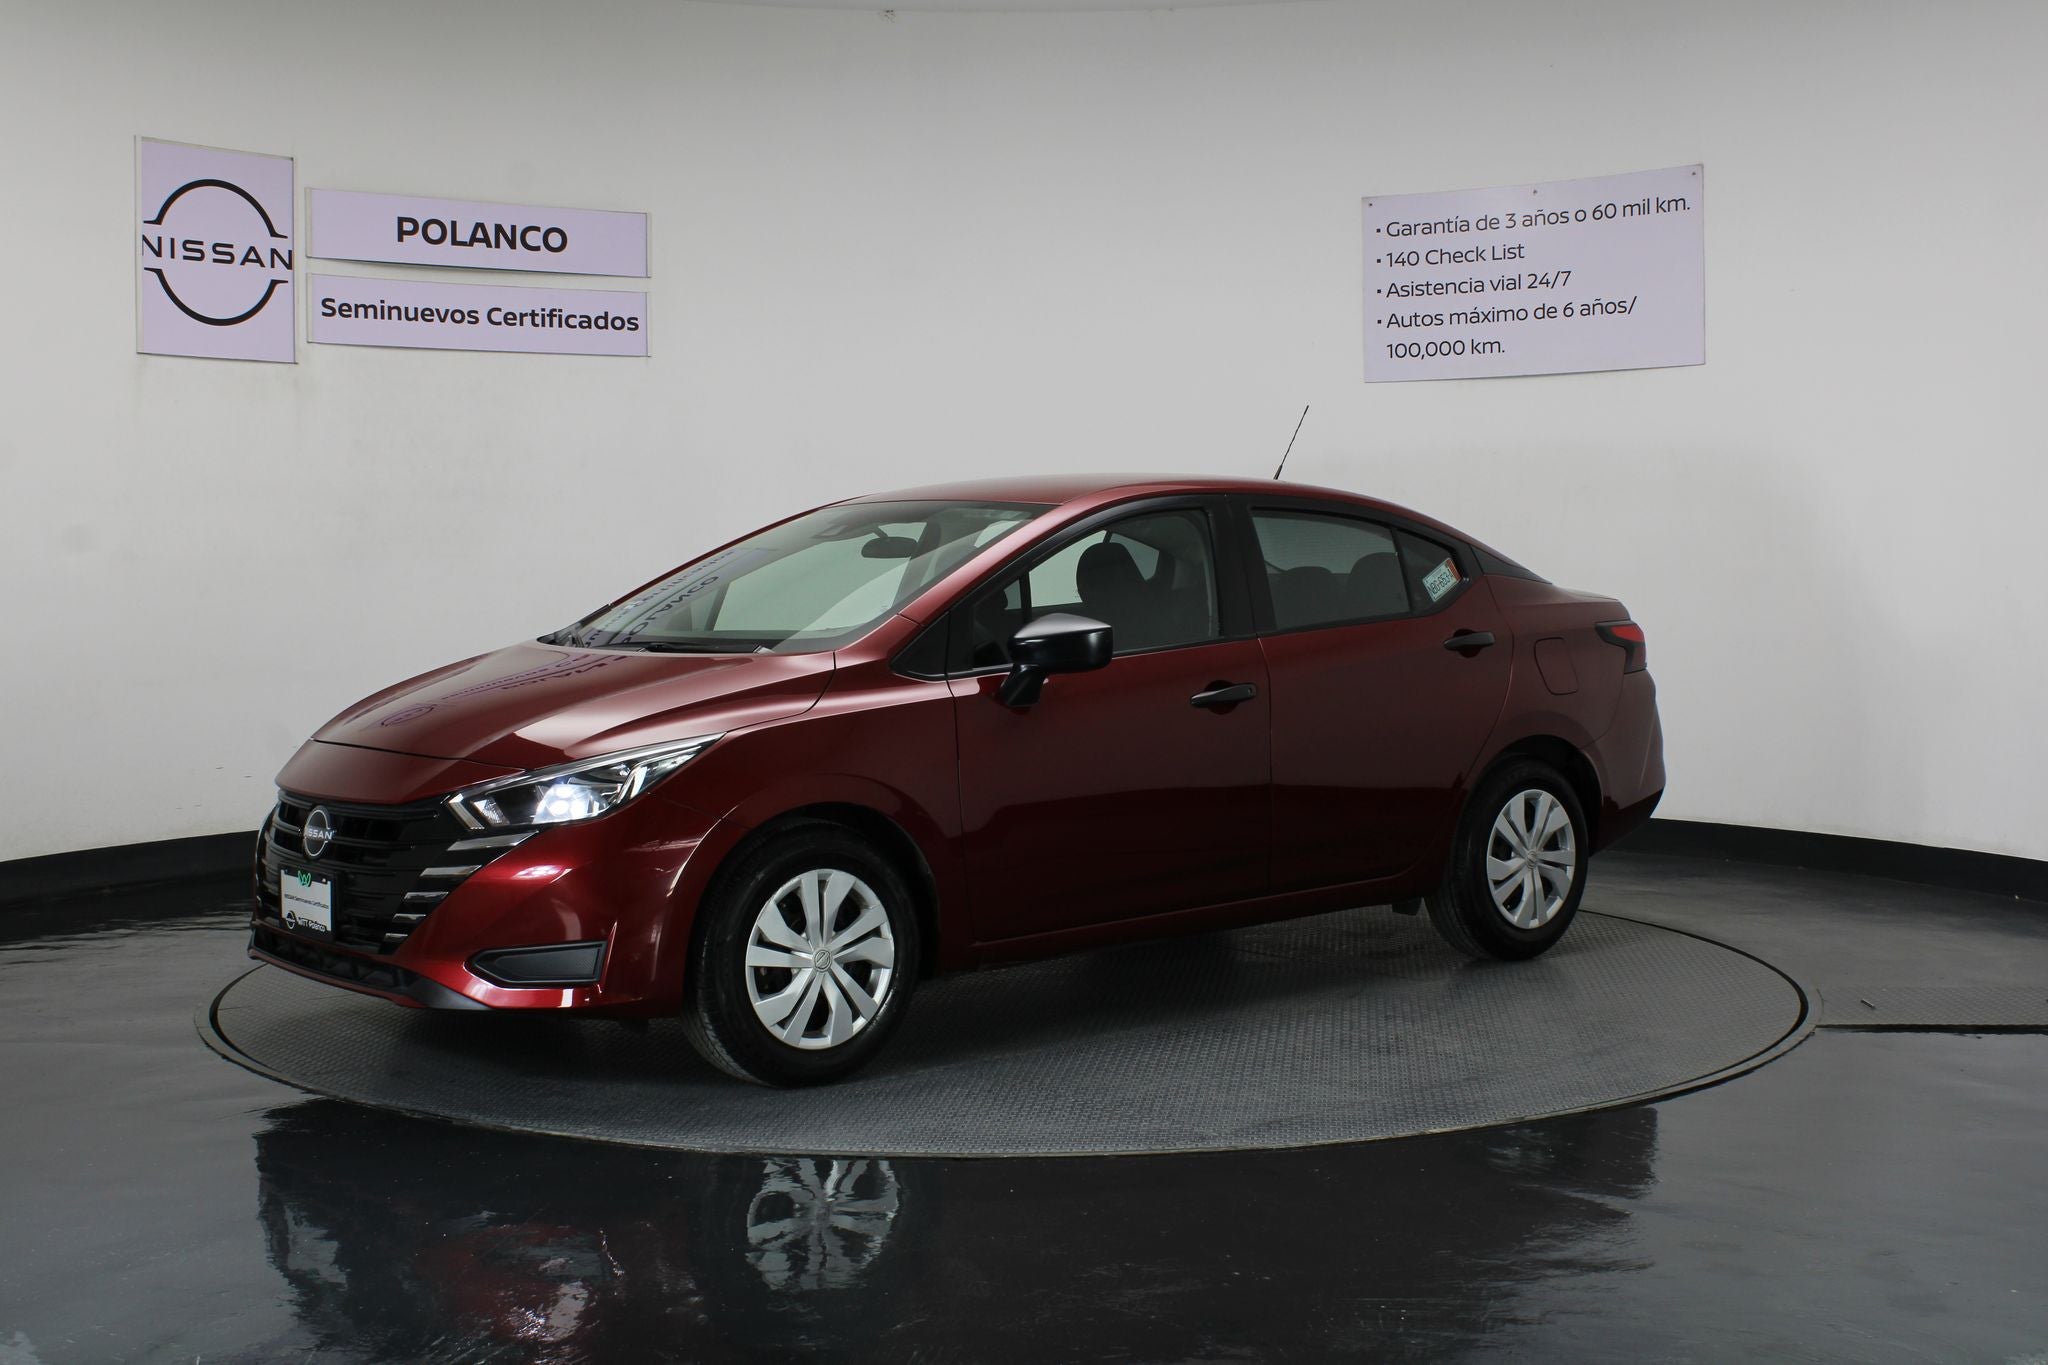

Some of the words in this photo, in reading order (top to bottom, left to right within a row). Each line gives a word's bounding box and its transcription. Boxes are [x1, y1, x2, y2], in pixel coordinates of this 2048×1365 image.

[1386, 216, 1470, 237] Garantía
[1476, 214, 1500, 231] de
[1505, 213, 1516, 229] 3
[1522, 209, 1569, 227] años
[1575, 209, 1586, 222] o
[1592, 203, 1617, 220] 60
[1623, 198, 1650, 217] mil
[1656, 197, 1690, 213] km.
[397, 216, 568, 253] POLANCO
[142, 234, 293, 270] NISSAN
[1386, 251, 1419, 267] 140
[1425, 246, 1486, 265] Check
[1492, 244, 1525, 260] List
[1386, 277, 1484, 298] Asistencia
[1489, 274, 1521, 291] vial
[1527, 271, 1572, 289] 24/7
[321, 298, 479, 325] Seminuevos
[487, 307, 639, 331] Certificados
[1387, 312, 1444, 328] Autos
[1450, 307, 1528, 325] máximo
[1534, 303, 1558, 319] de
[1563, 302, 1574, 318] 6
[1580, 296, 1637, 316] años/
[1387, 340, 1465, 360] 100,000
[1471, 339, 1505, 354] km.
